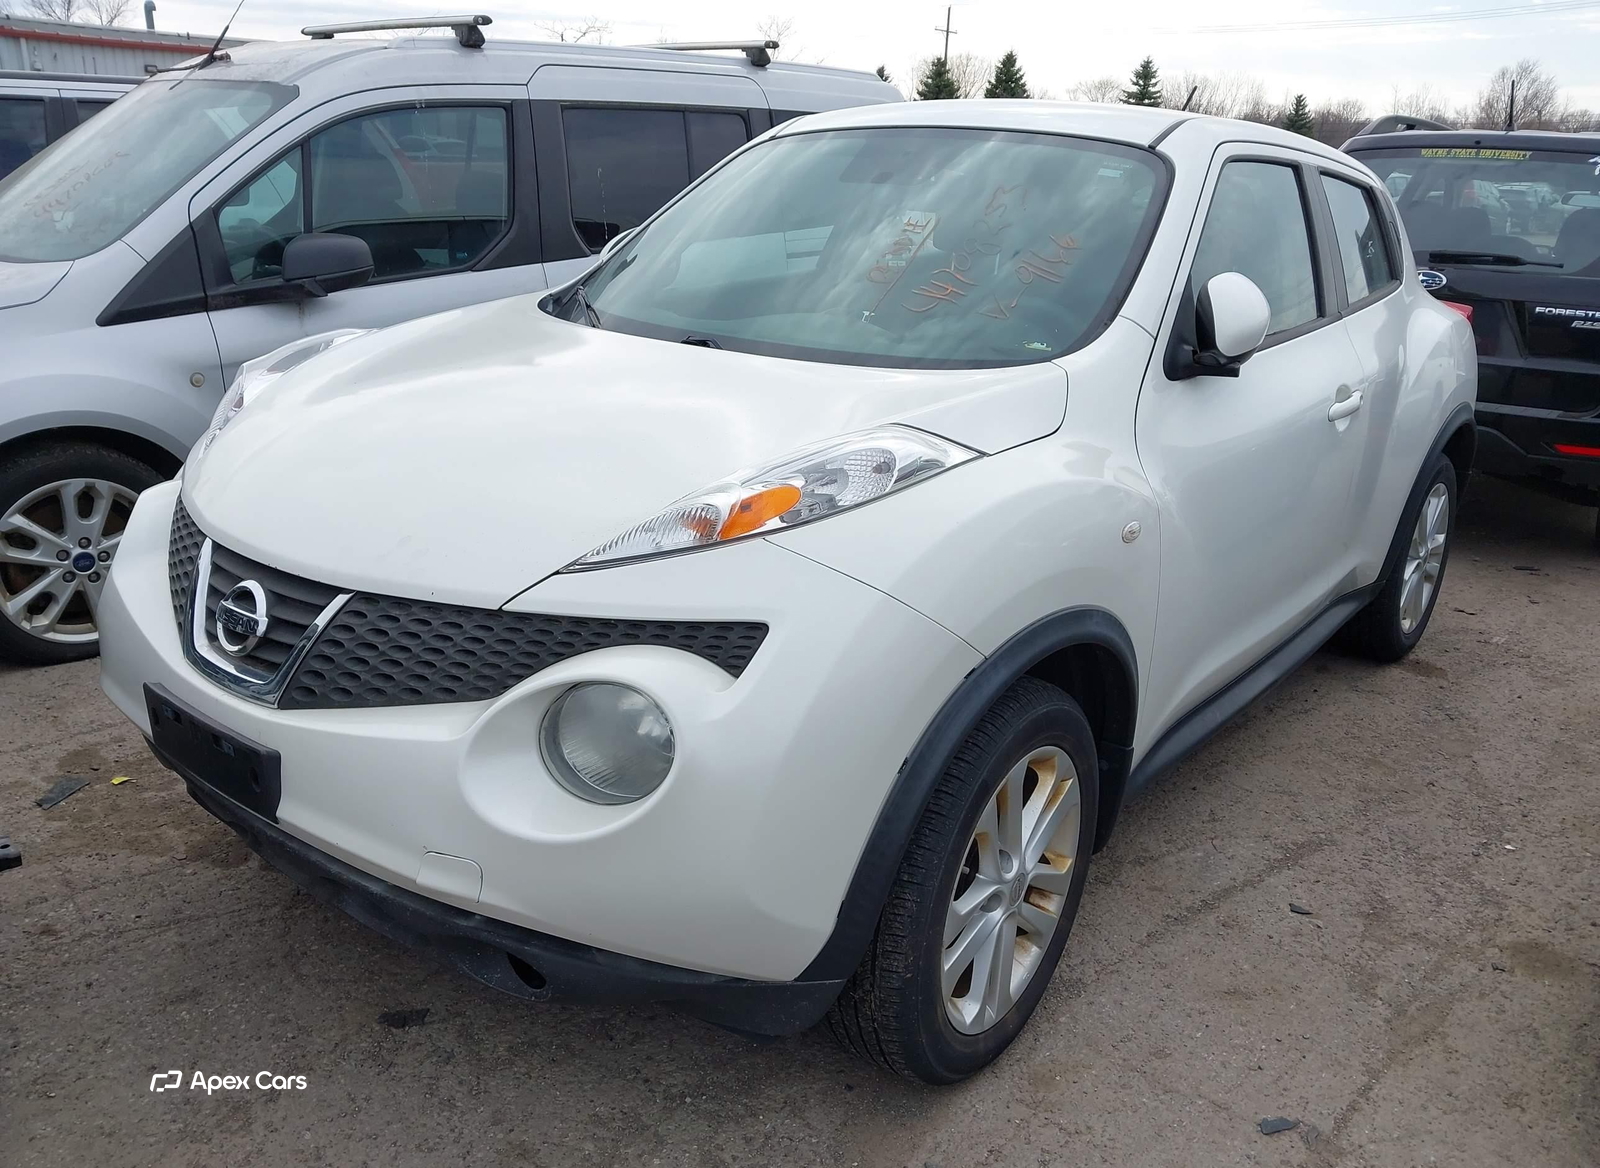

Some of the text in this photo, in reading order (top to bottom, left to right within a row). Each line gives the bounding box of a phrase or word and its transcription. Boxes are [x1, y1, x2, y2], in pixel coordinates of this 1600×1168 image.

[1421, 148, 1449, 156] WAYNE
[1451, 148, 1478, 156] STATE
[1480, 149, 1533, 159] UNIVERSITY
